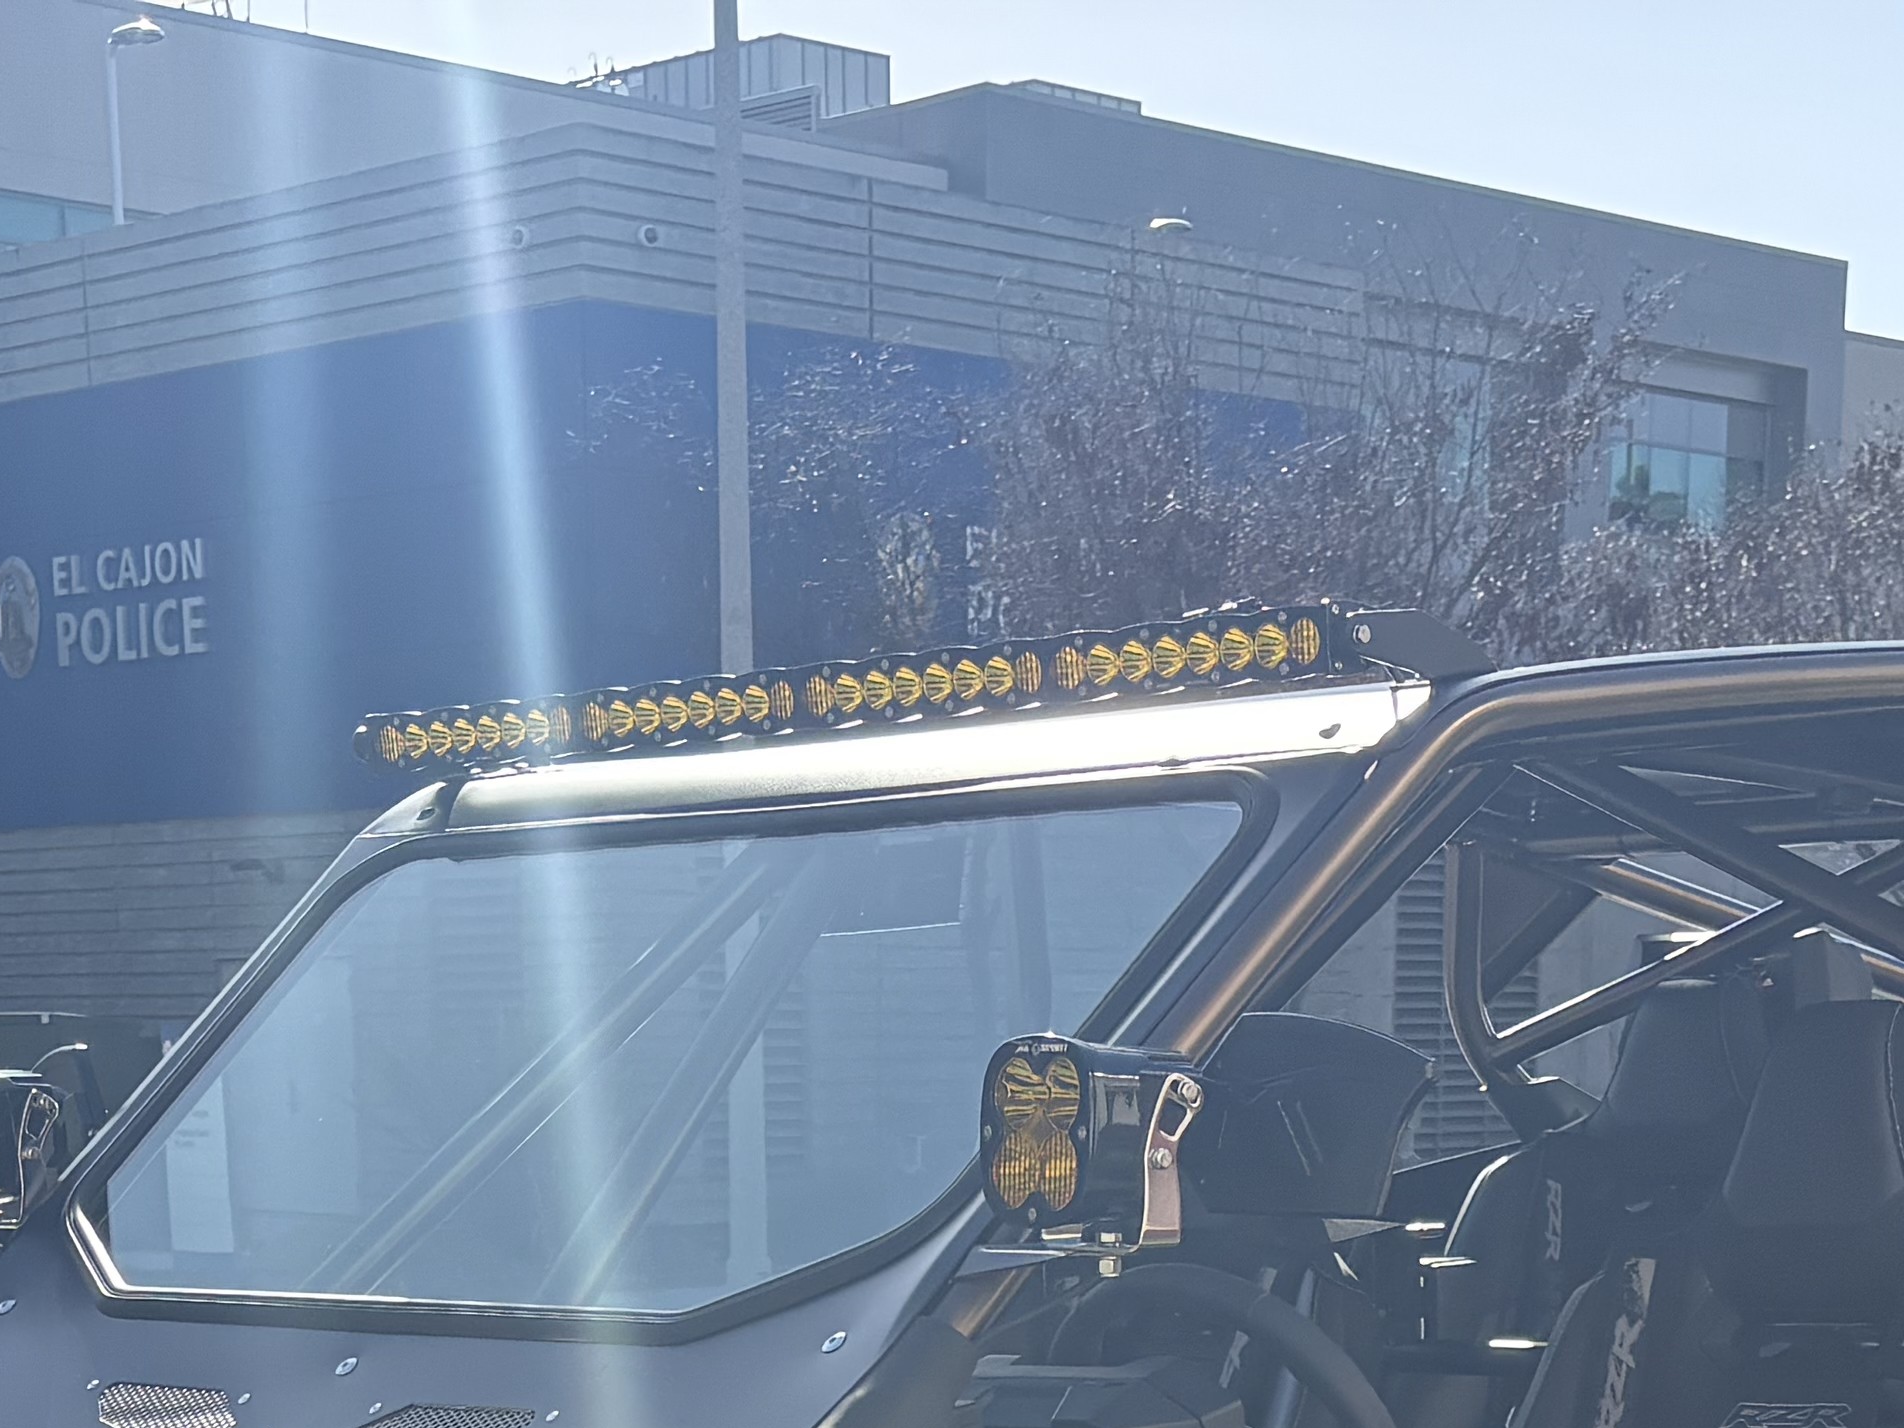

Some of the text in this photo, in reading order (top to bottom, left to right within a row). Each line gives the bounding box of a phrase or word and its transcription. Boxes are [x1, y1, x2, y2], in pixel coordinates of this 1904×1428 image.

[52, 537, 205, 596] EL CAJON
[56, 596, 209, 667] POLICE
